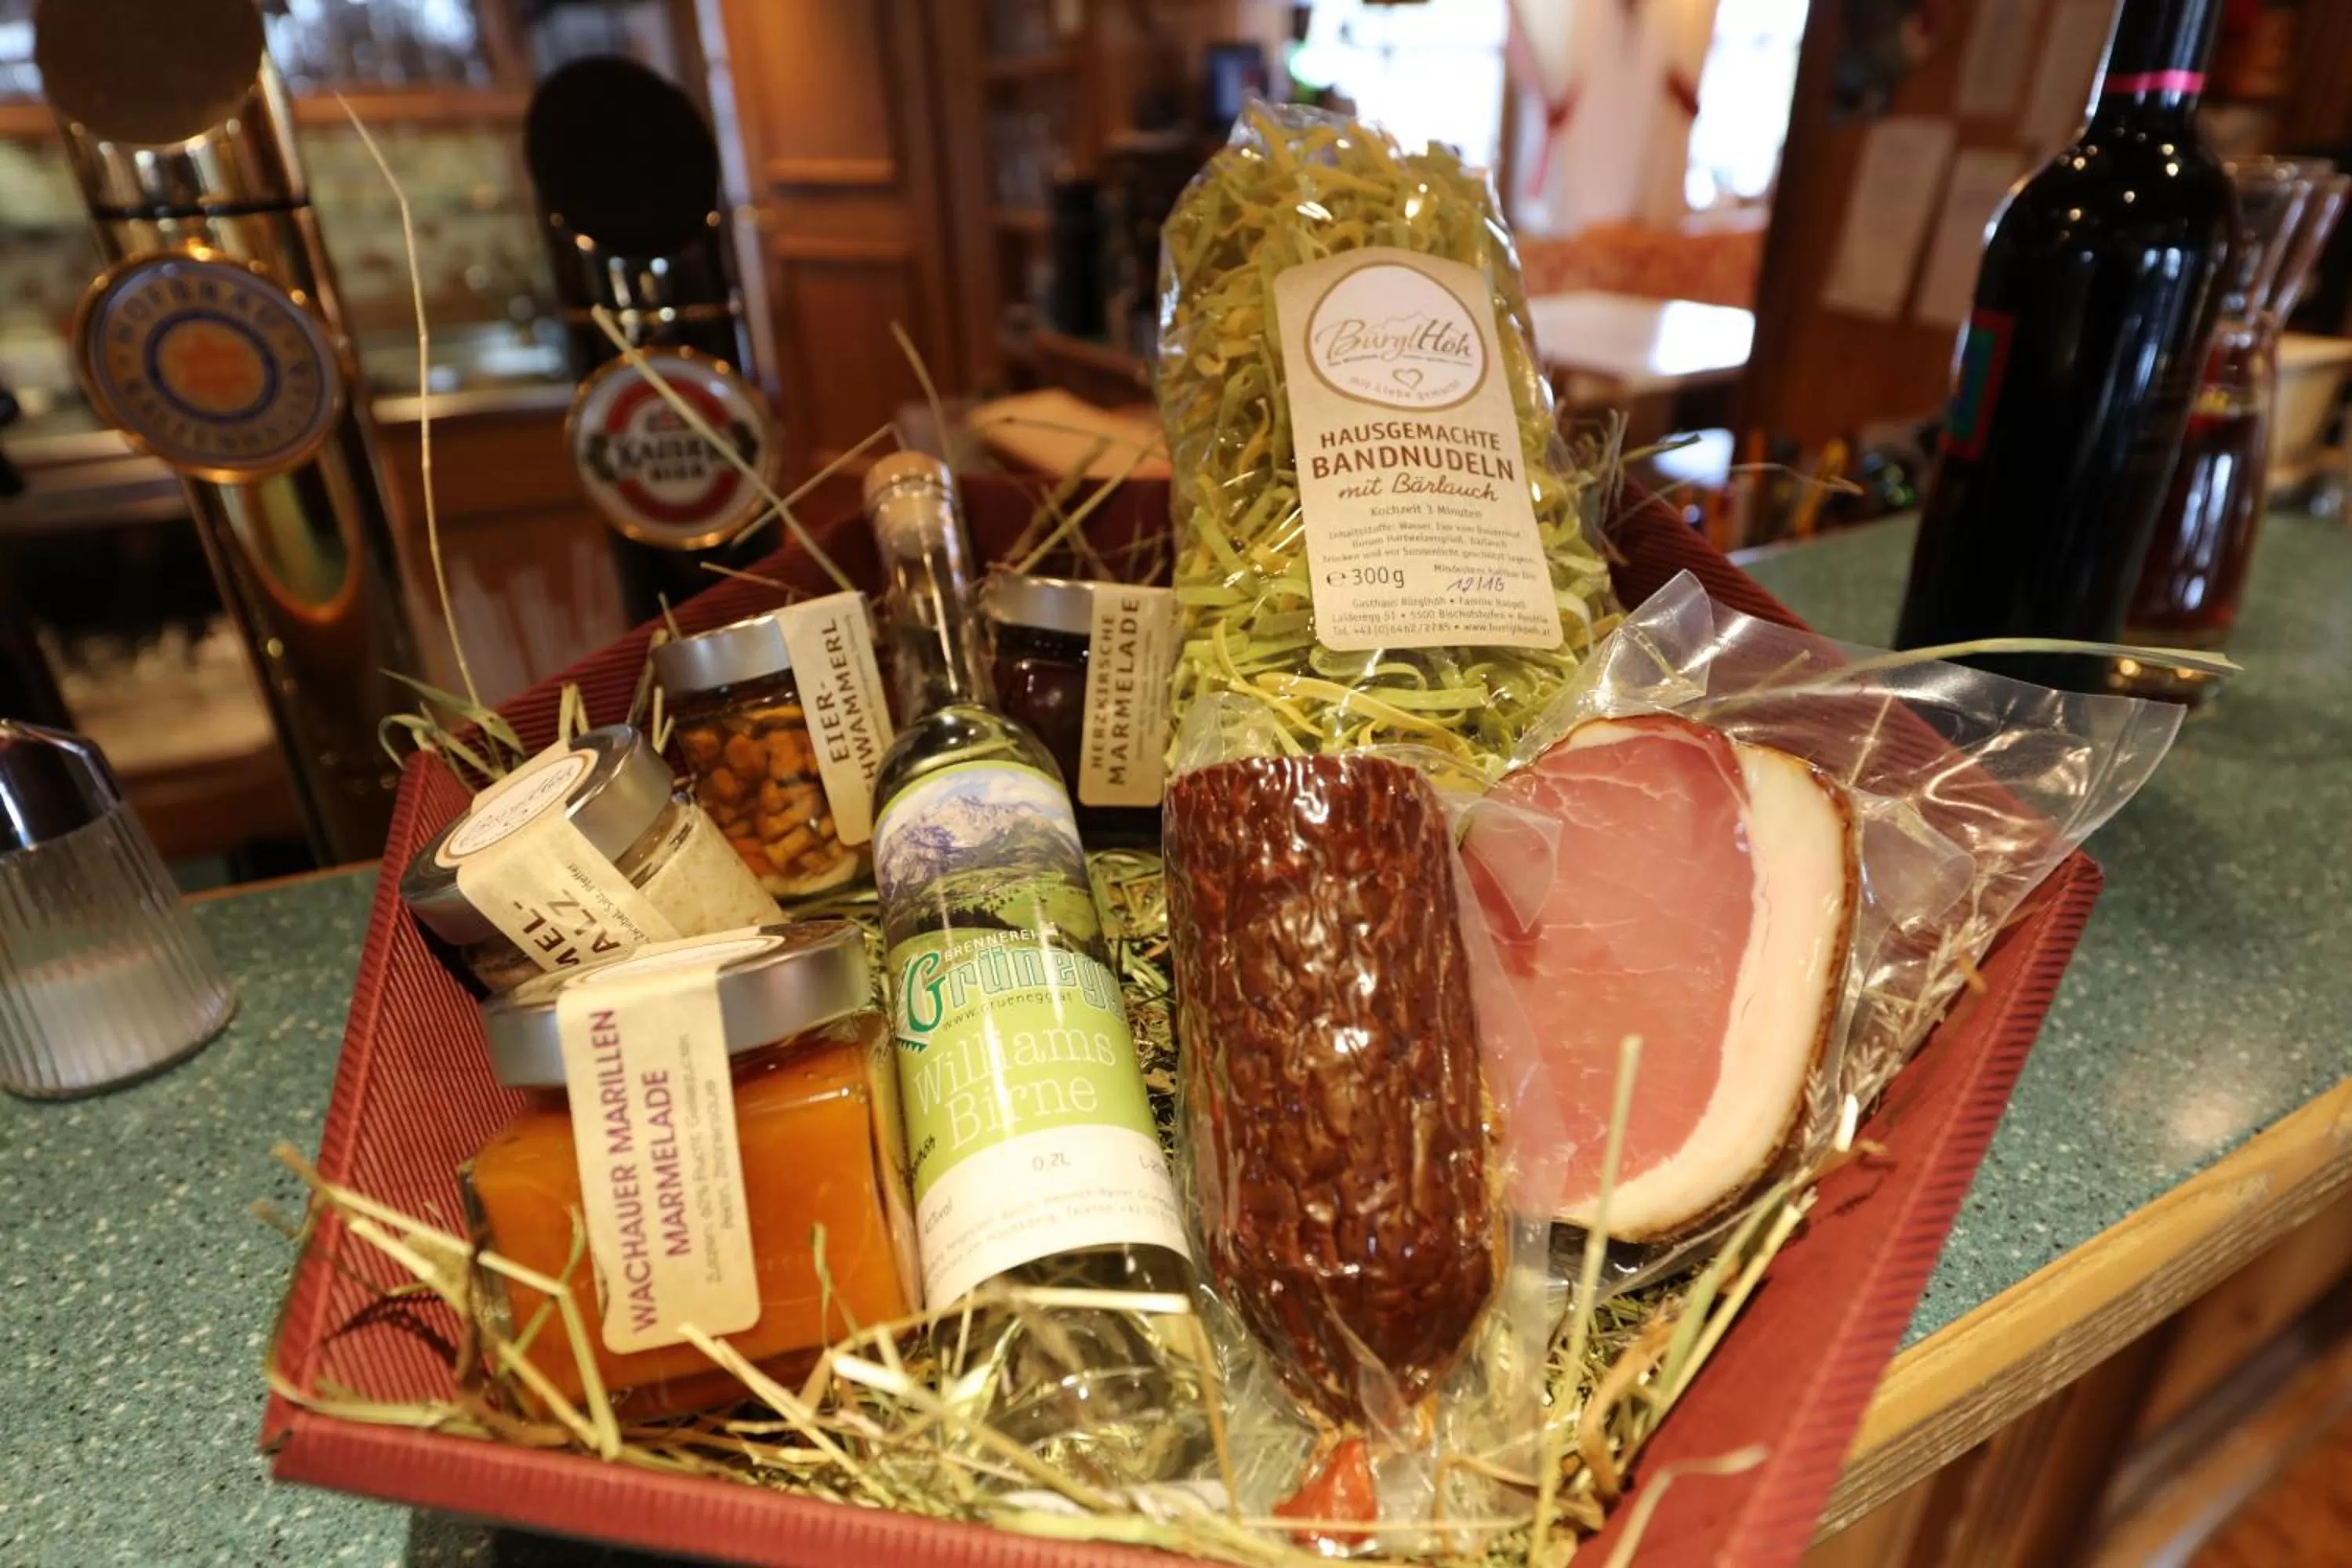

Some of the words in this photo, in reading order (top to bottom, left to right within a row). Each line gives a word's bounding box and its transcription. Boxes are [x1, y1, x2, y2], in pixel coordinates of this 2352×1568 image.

[1311, 445, 1515, 482] BANDNUDELN
[1320, 421, 1501, 452] HAUSGEMACHTE
[1338, 475, 1384, 500] mit
[1392, 471, 1499, 503] Bärlauch
[1370, 503, 1422, 517] Kochzeit
[1426, 504, 1434, 516] 3
[1437, 504, 1484, 518] Minuten
[815, 681, 851, 764] EIER-
[822, 617, 877, 793] HWAMMERL
[1108, 596, 1140, 786] MARMELADE
[944, 928, 1036, 963] BRENNEREI
[590, 1008, 634, 1156] MARILLEN
[913, 1027, 1117, 1116] Williams
[944, 1075, 1098, 1152] Birne
[641, 1067, 691, 1258] MARMELADE
[609, 1164, 659, 1333] WACHAUER
